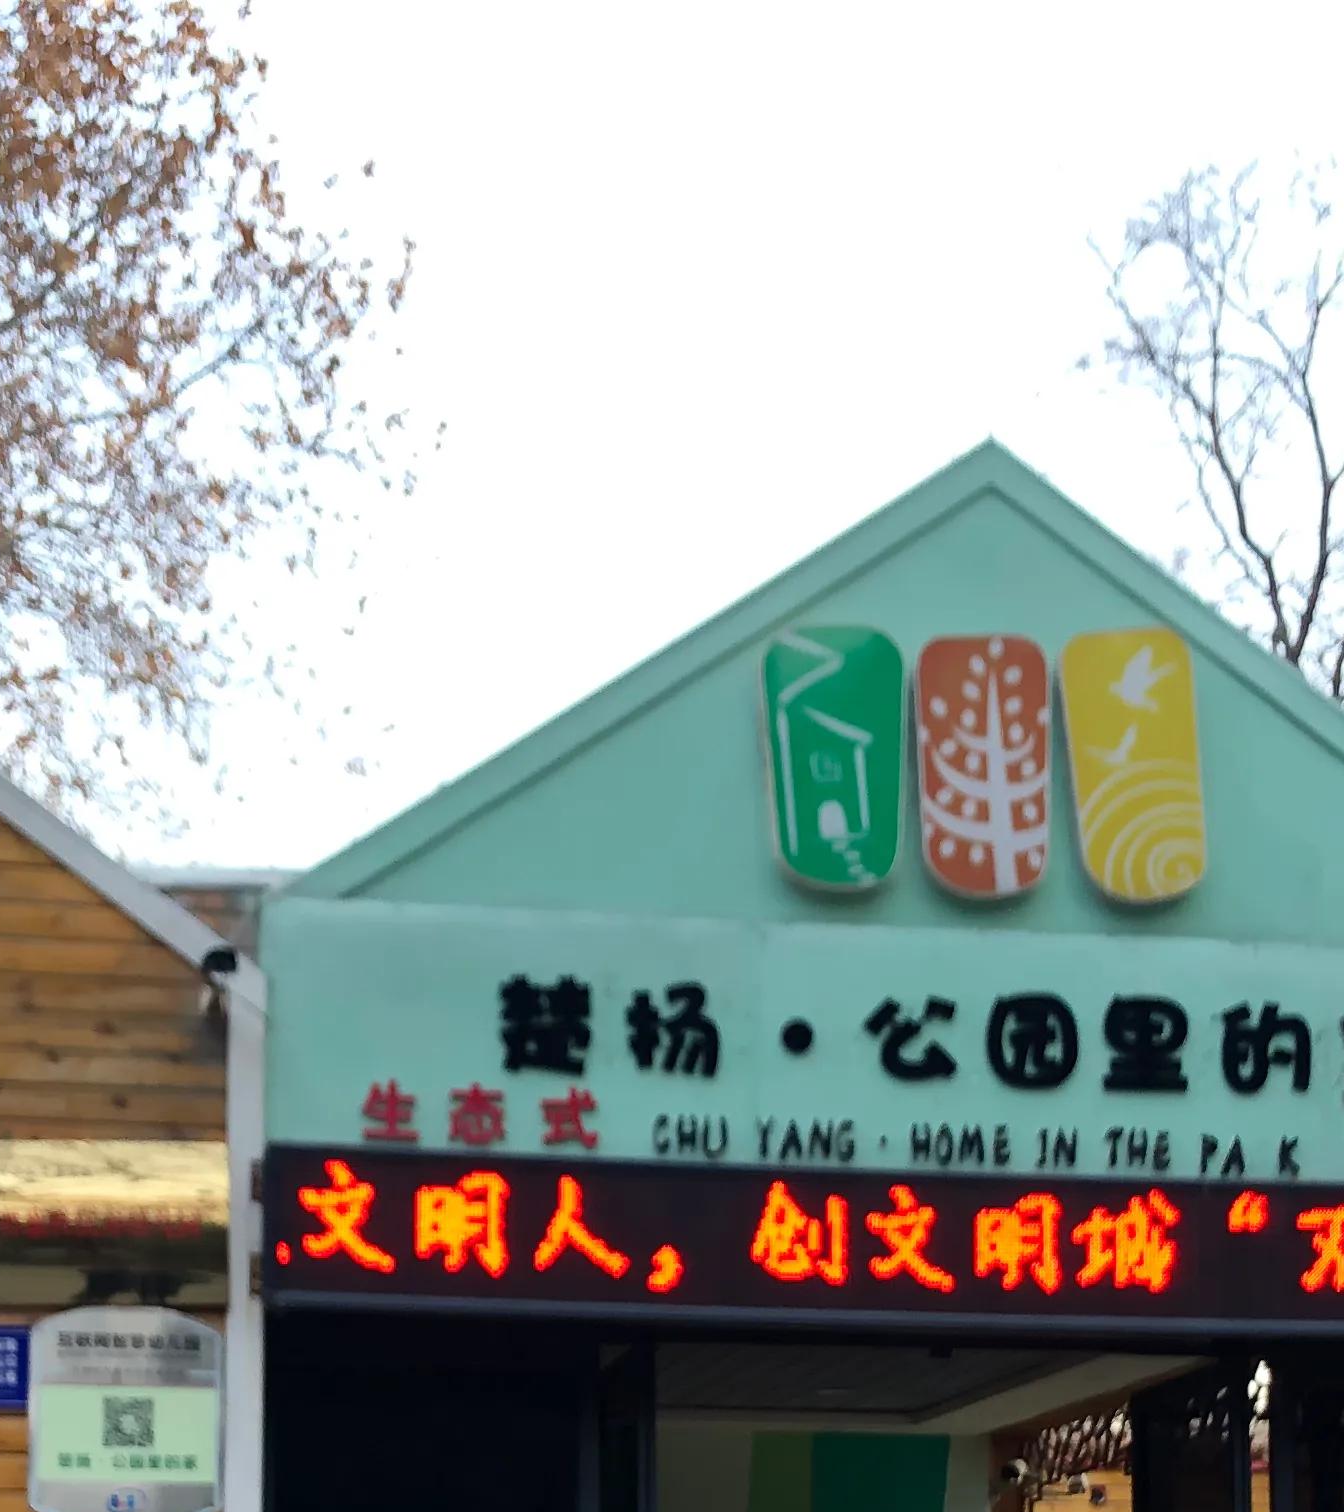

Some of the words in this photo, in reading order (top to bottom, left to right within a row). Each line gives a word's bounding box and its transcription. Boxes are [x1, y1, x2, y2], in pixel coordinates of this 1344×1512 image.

[362, 1081, 600, 1149] 生态式
[655, 1115, 729, 1159] CHU
[757, 1120, 856, 1162] YANG
[910, 1122, 1012, 1169] HOME
[1035, 1127, 1079, 1167] IN
[1105, 1127, 1172, 1171] THE
